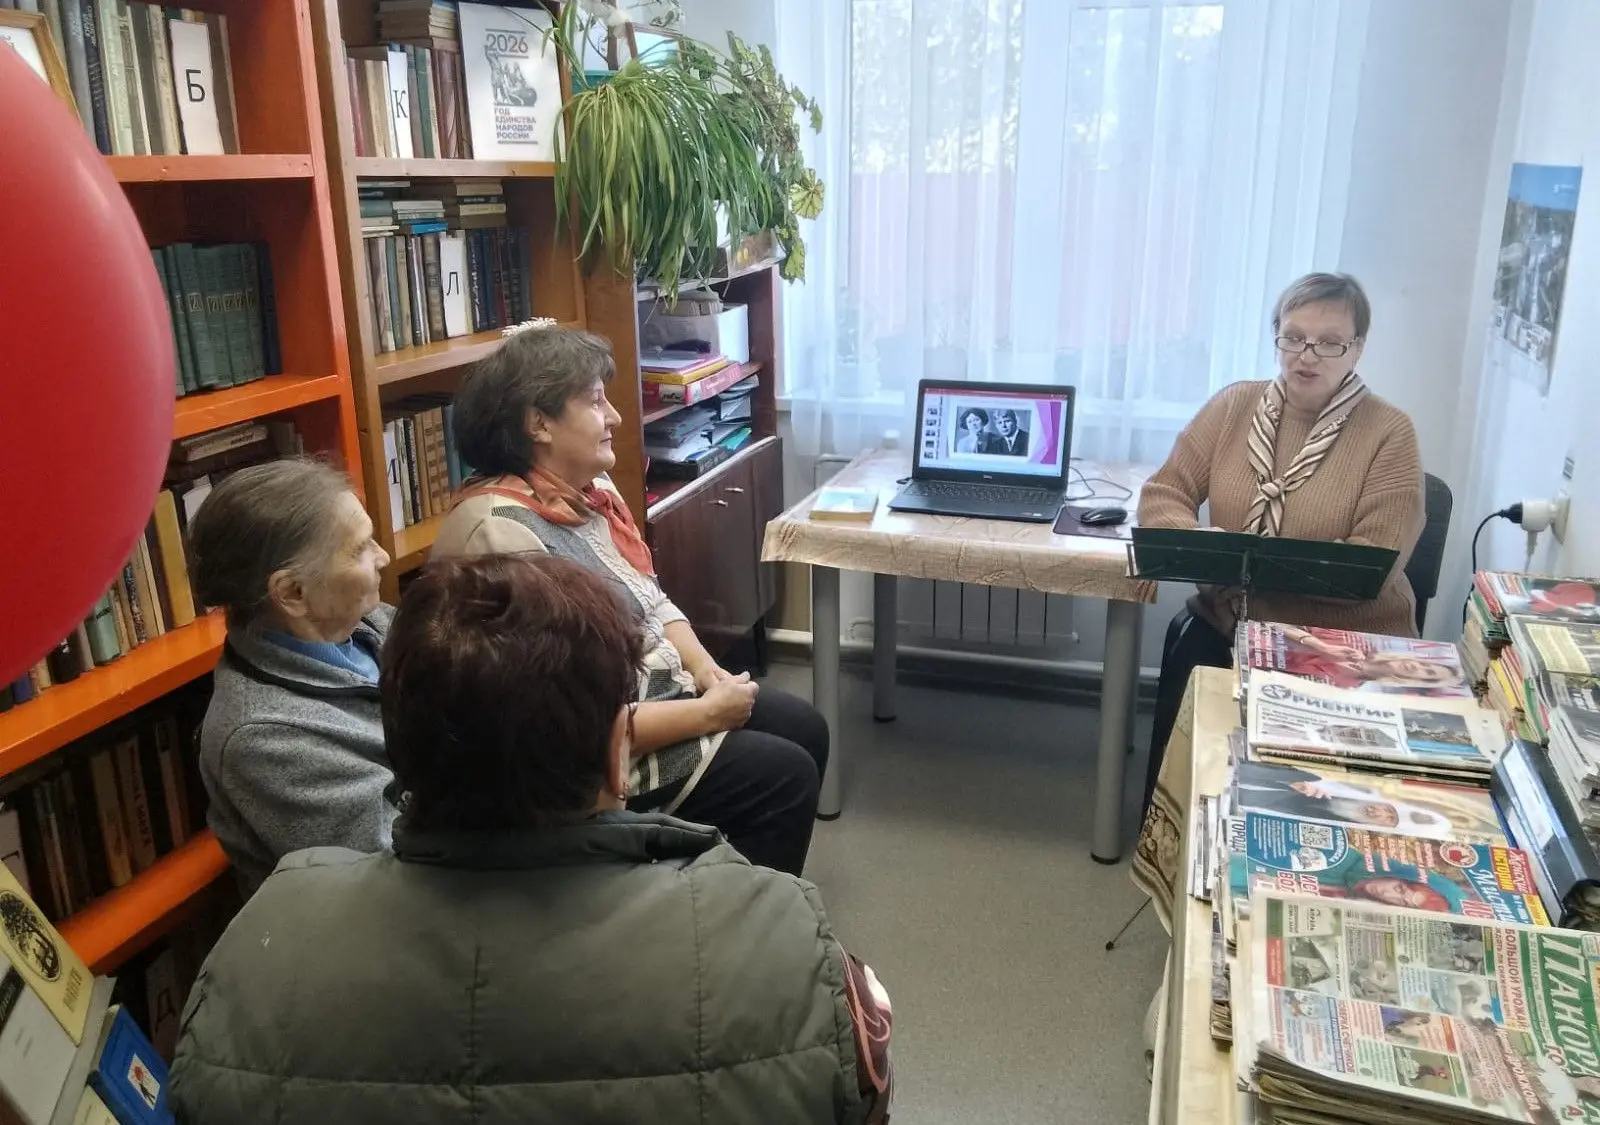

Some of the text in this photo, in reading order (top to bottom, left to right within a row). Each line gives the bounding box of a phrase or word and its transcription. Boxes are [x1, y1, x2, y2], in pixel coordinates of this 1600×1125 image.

[486, 33, 529, 53] 2026
[185, 68, 206, 102] Б
[393, 89, 408, 118] К
[494, 107, 511, 116] ГОД
[496, 124, 534, 132] НАРОДОВ
[497, 131, 530, 140] РОССИИ
[446, 271, 459, 296] Л
[1505, 928, 1521, 983] БОЛЬШОЙ
